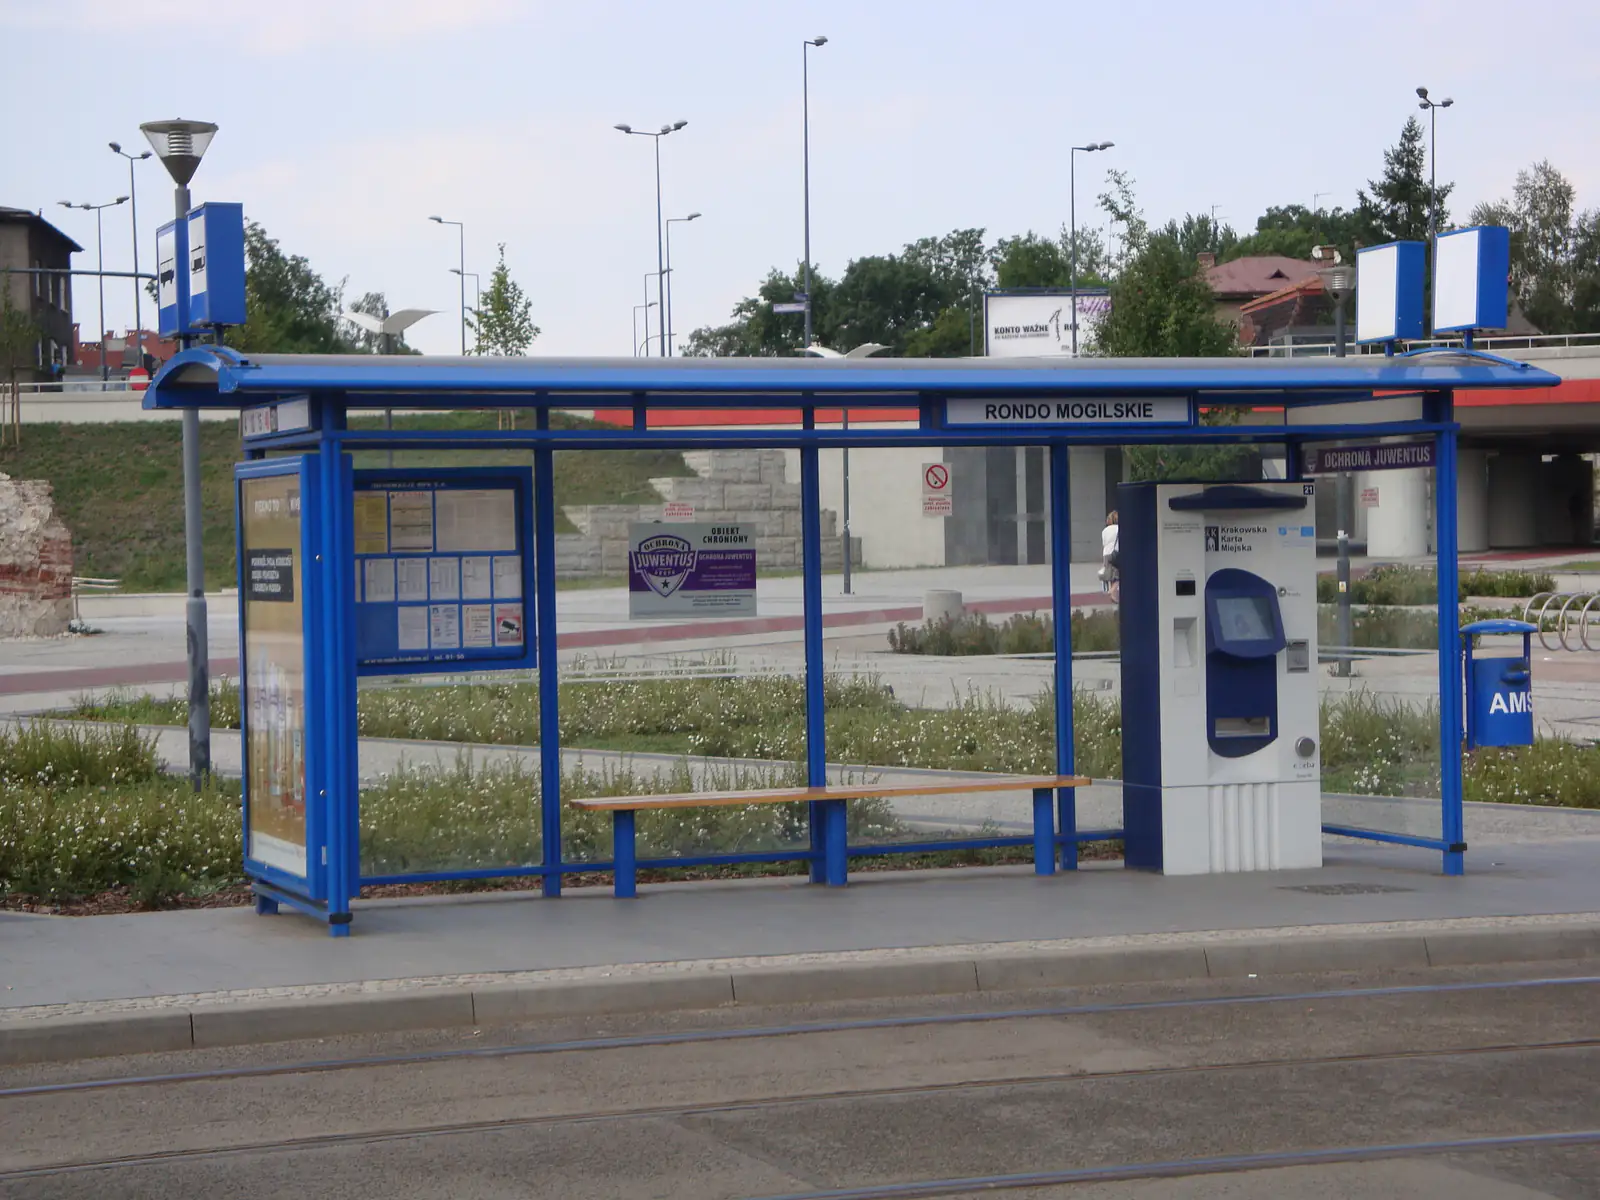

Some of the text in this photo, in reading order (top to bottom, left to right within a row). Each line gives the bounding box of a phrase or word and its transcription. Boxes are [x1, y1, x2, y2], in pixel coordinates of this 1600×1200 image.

[994, 326, 1020, 334] KONTO
[1022, 323, 1049, 333] WAŻNE
[985, 402, 1154, 420] RONDO MOGILSKIE
[1324, 446, 1431, 468] OCHRONA JUWENTUS
[1304, 485, 1313, 494] 21
[712, 527, 740, 535] OBIEKT
[1221, 526, 1268, 534] Krakowska
[702, 534, 748, 544] CHRONIONY
[1221, 535, 1243, 543] Karta
[643, 538, 685, 551] OCHRONA
[1221, 544, 1252, 553] Miejska
[637, 553, 694, 568] JUWENTUS
[699, 552, 753, 561] OCHRONA JUWENTUS
